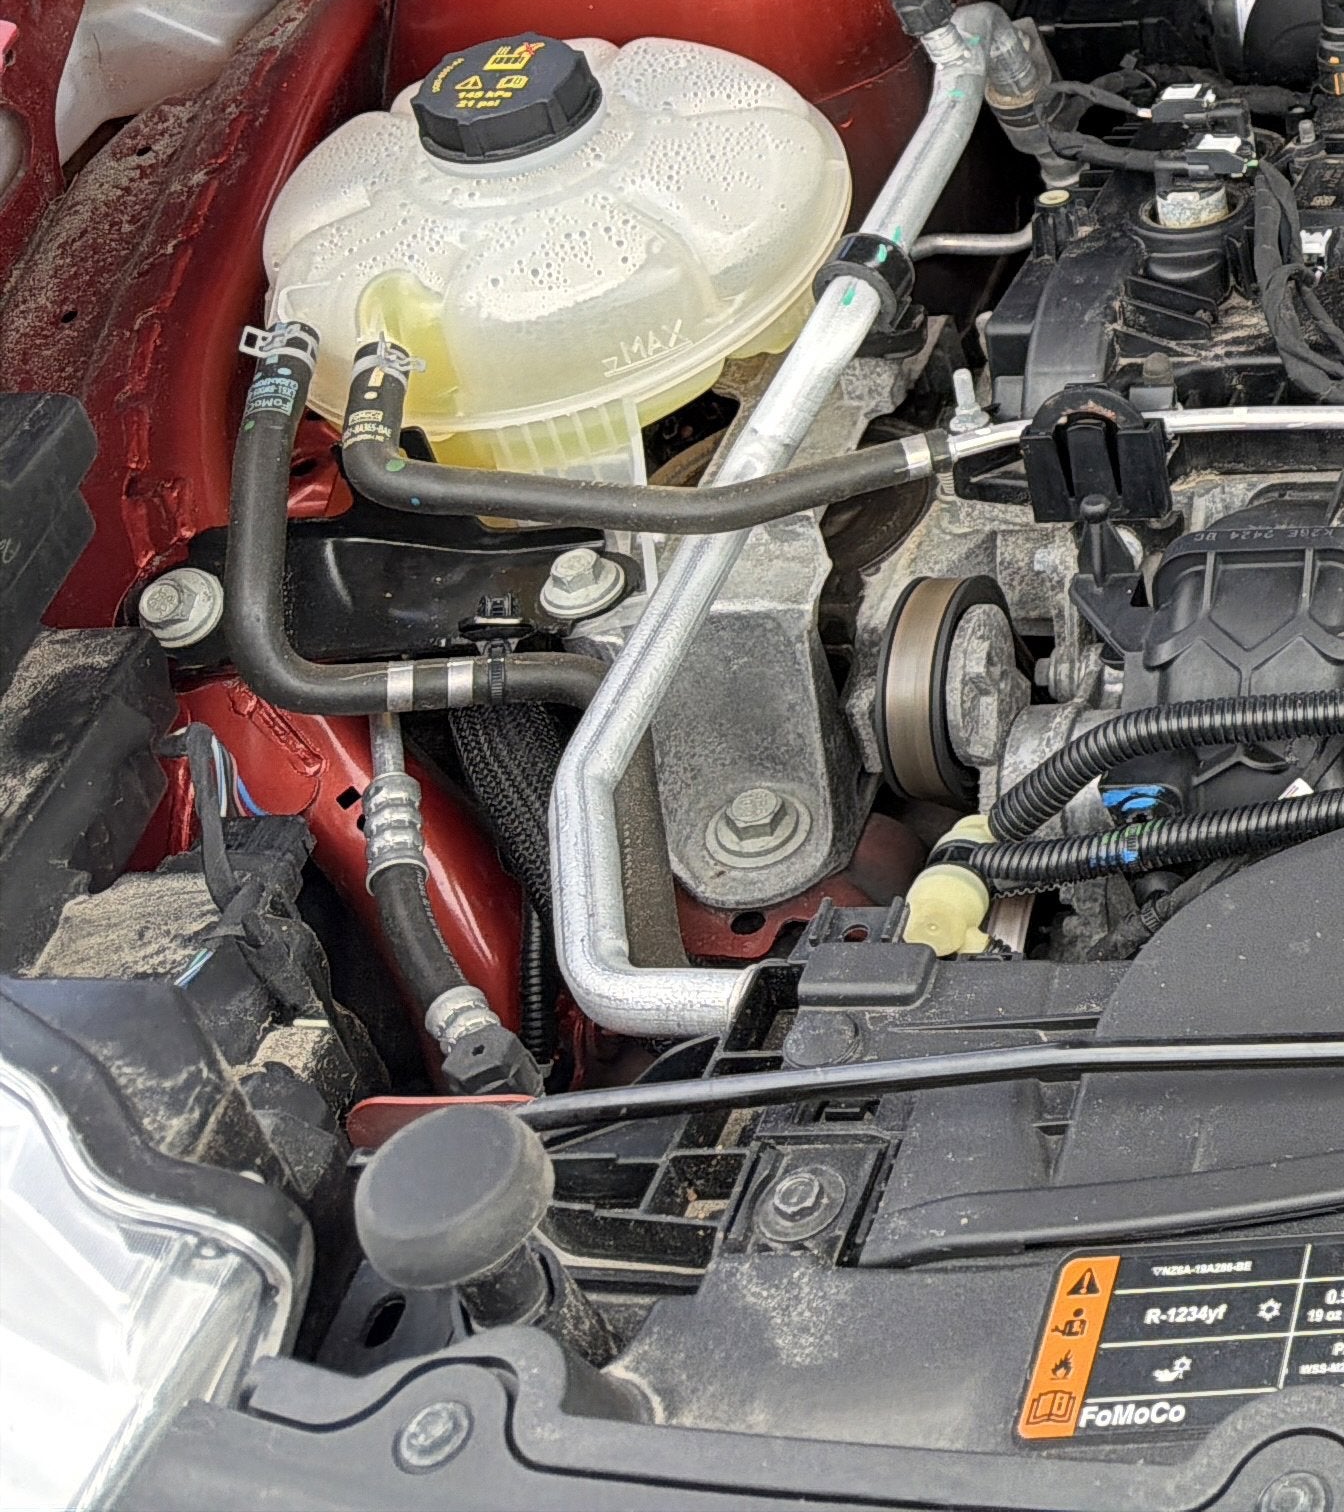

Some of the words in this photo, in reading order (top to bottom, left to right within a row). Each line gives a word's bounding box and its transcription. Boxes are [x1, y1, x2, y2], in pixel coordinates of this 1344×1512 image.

[620, 319, 689, 365] MAX
[247, 397, 291, 414] FoMoC
[1144, 1303, 1228, 1325] R-1234yf
[1306, 1309, 1324, 1323] 19
[1325, 1310, 1343, 1321] oz
[1079, 1402, 1187, 1428] FoMoCo
